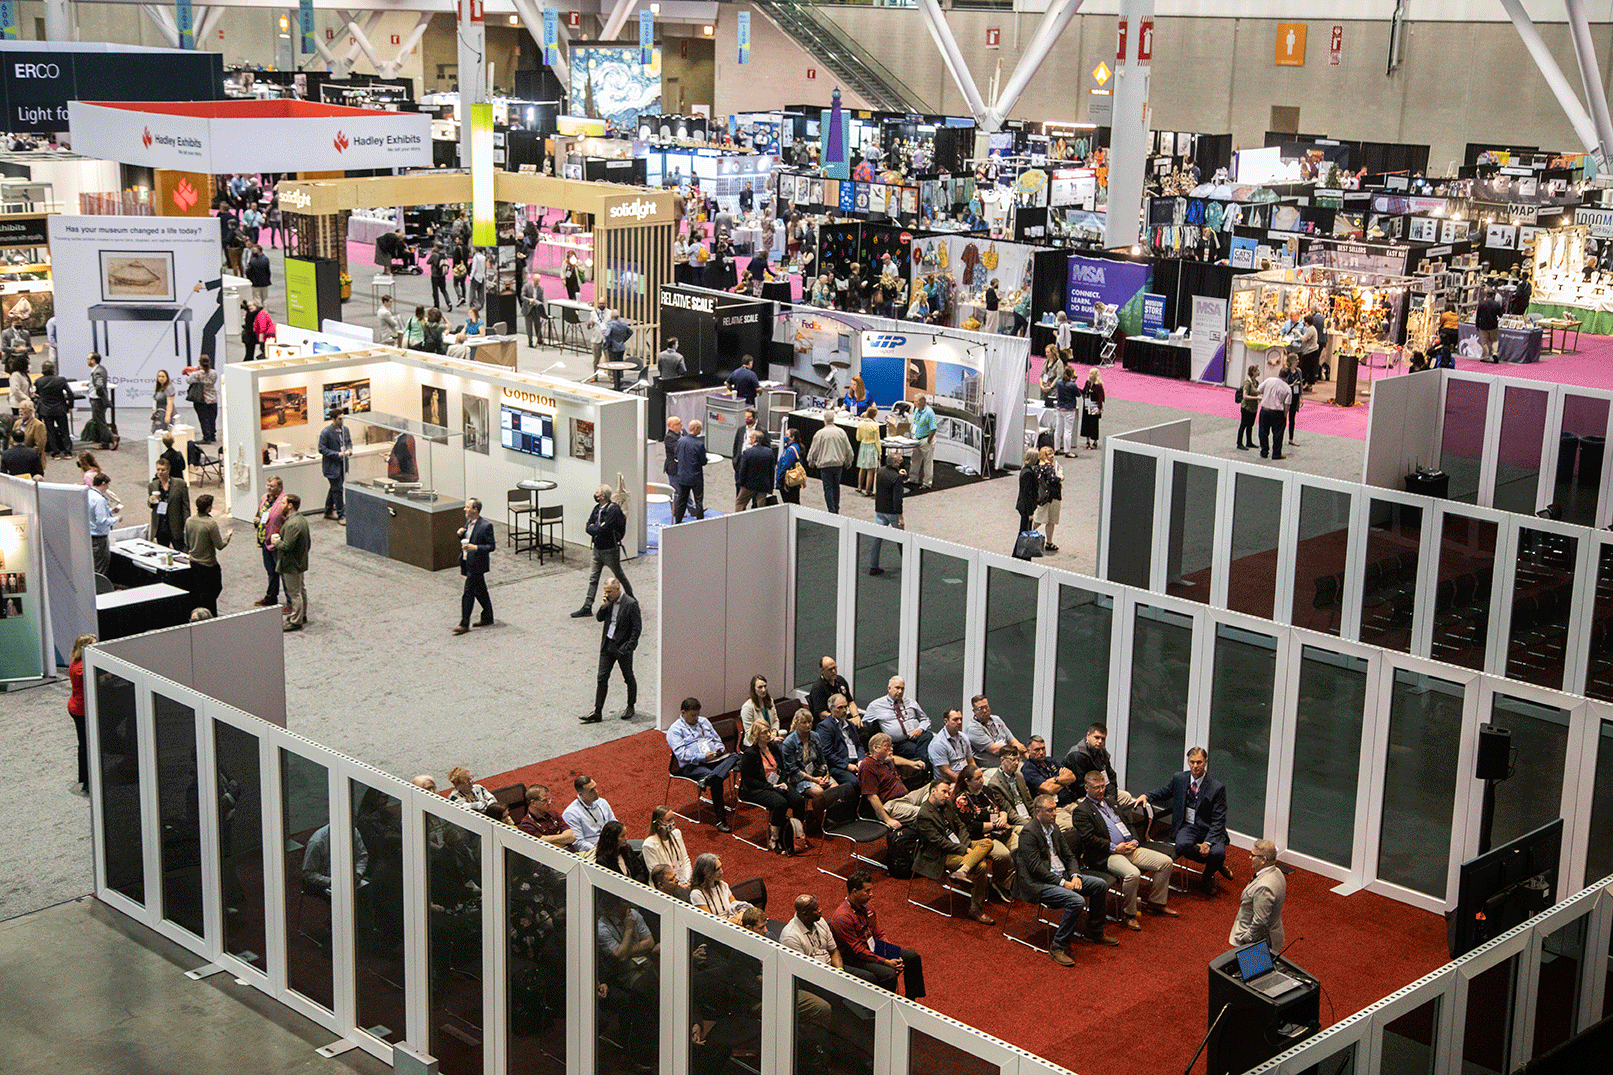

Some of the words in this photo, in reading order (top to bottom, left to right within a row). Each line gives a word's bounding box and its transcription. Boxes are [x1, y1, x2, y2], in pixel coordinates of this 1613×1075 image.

[14, 63, 60, 79] ERCO
[18, 106, 53, 125] Light
[57, 105, 69, 121] fo
[155, 134, 175, 148] Hadley
[177, 136, 202, 149] Exhibits
[353, 136, 384, 147] Hadley
[387, 135, 421, 145] Exhibits
[610, 198, 657, 220] solidlight
[65, 225, 79, 233] Has
[81, 226, 97, 235] your
[98, 226, 128, 234] museum
[130, 226, 159, 236] changed
[167, 226, 176, 234] life
[178, 227, 202, 236] today?
[1234, 250, 1251, 258] CAT'S
[1337, 244, 1349, 253] BEST
[1349, 246, 1367, 255] SELLERS
[1386, 249, 1397, 258] EASY
[1072, 264, 1106, 284] MSA
[660, 291, 691, 310] RELATIVE
[691, 296, 714, 313] SCALE
[1070, 304, 1080, 312] DO
[1144, 305, 1163, 315] STORE
[1196, 300, 1221, 317] MSA
[722, 315, 743, 326] RELATIVE
[743, 313, 759, 324] SCALE
[801, 319, 822, 330] FedEx
[503, 387, 556, 408] Goppion
[709, 411, 726, 422] FedEx
